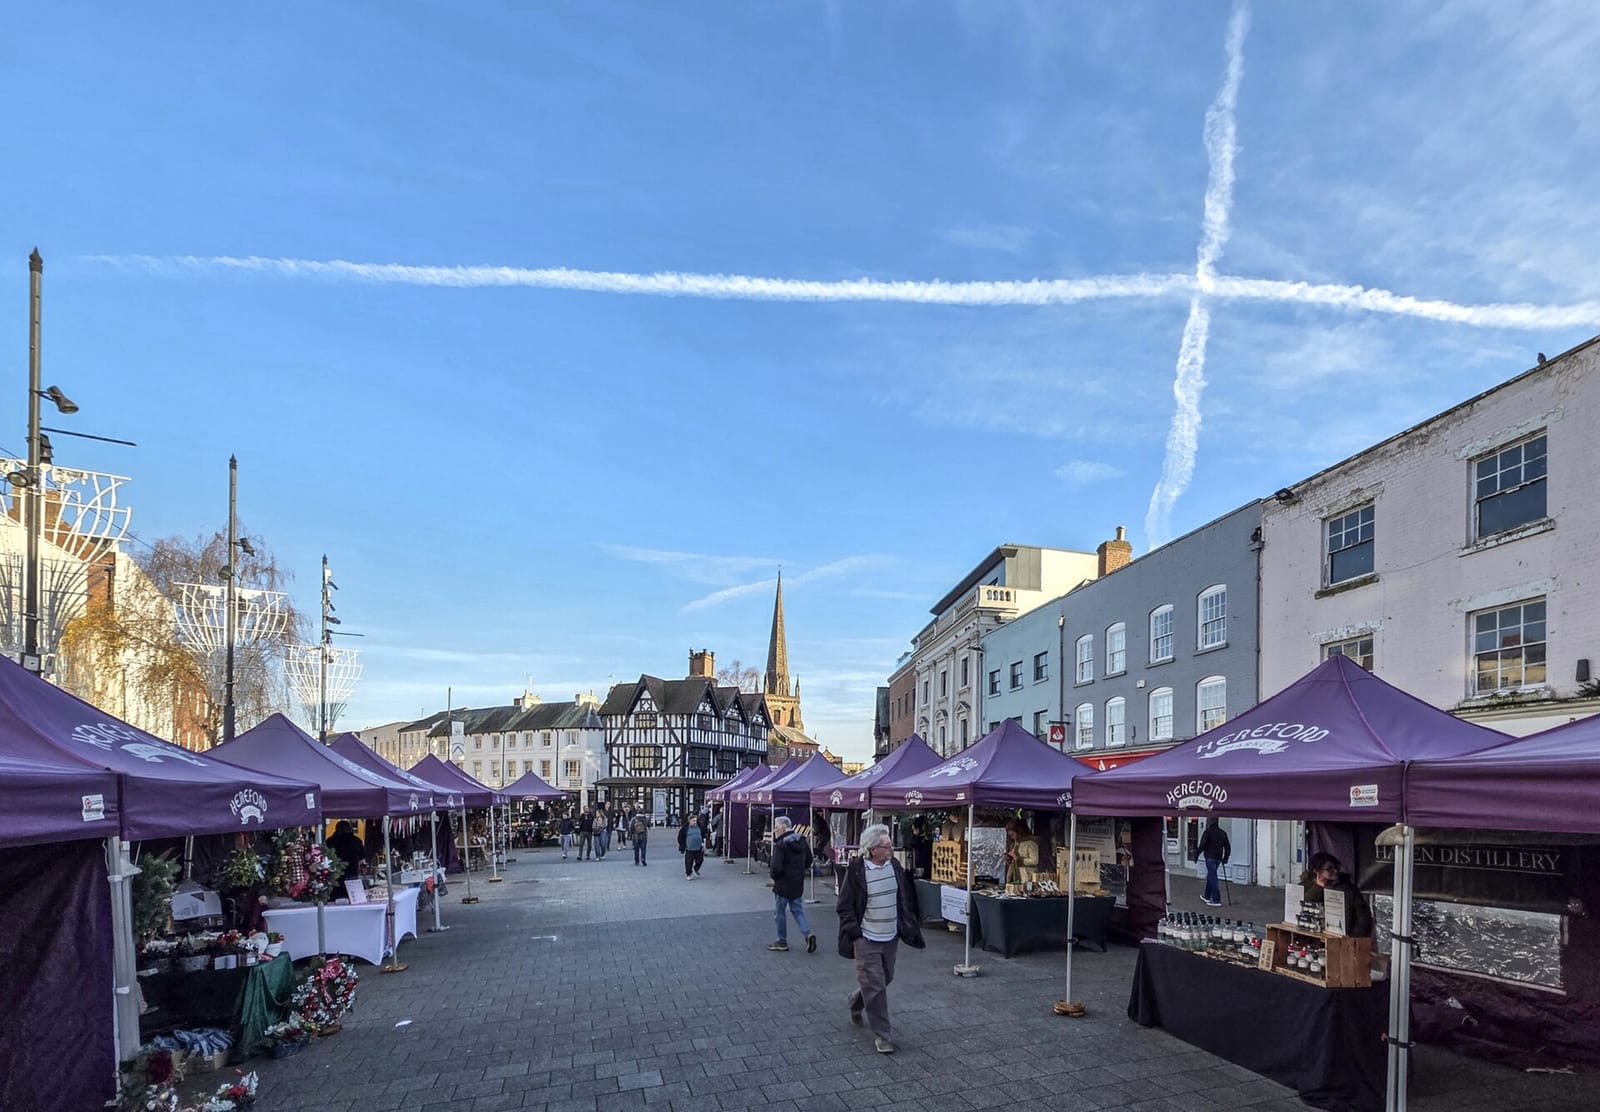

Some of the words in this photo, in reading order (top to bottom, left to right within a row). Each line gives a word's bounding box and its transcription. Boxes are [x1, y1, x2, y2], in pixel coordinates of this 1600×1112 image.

[1196, 723, 1330, 755] HEREFORD
[229, 788, 268, 816] HEREFORD
[1166, 780, 1227, 804] HEREFORD
[1375, 846, 1434, 862] HAEN
[1440, 848, 1560, 870] DISTILLERY
